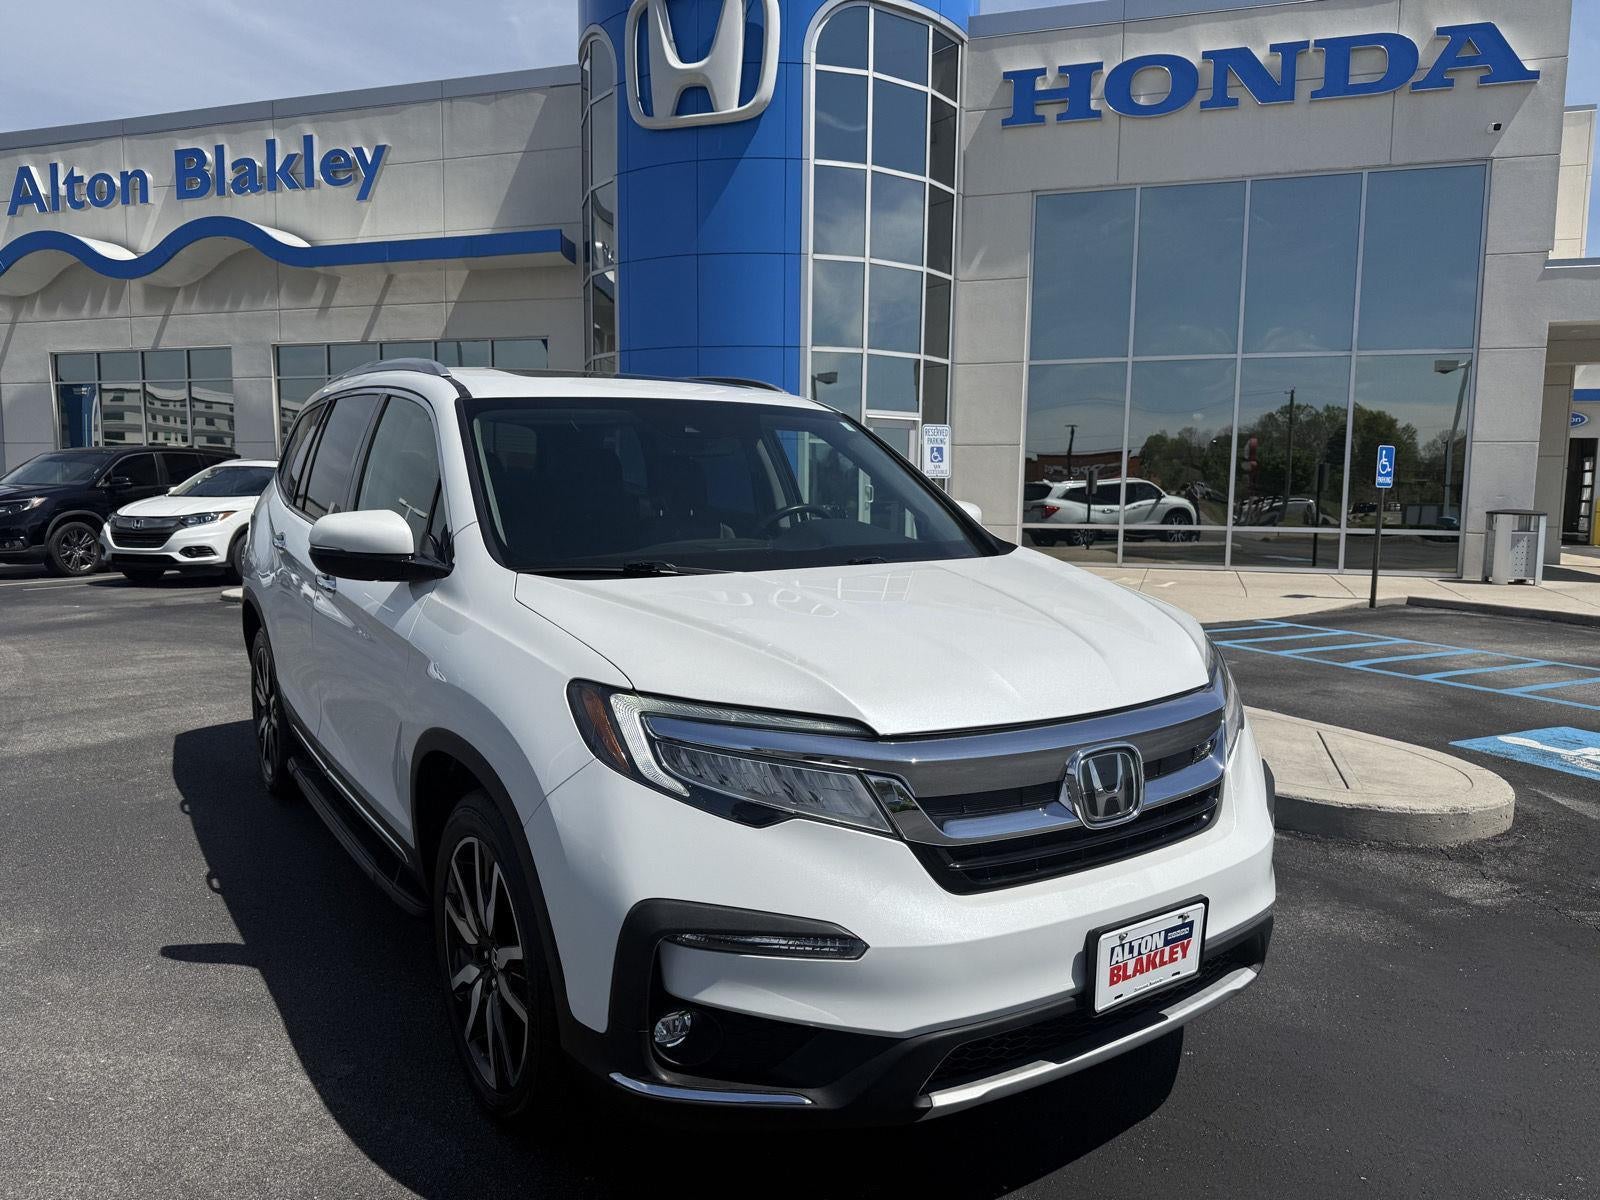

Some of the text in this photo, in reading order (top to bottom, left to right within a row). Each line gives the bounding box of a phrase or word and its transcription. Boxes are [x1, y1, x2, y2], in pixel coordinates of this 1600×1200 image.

[1001, 21, 1540, 128] HONDA
[7, 134, 390, 216] Alton Blakley
[925, 427, 949, 436] RESERVED
[927, 437, 946, 445] PARKING
[1377, 476, 1392, 484] PARKING
[1109, 939, 1193, 987] BLAKLEY
[1111, 930, 1165, 965] ALTON
